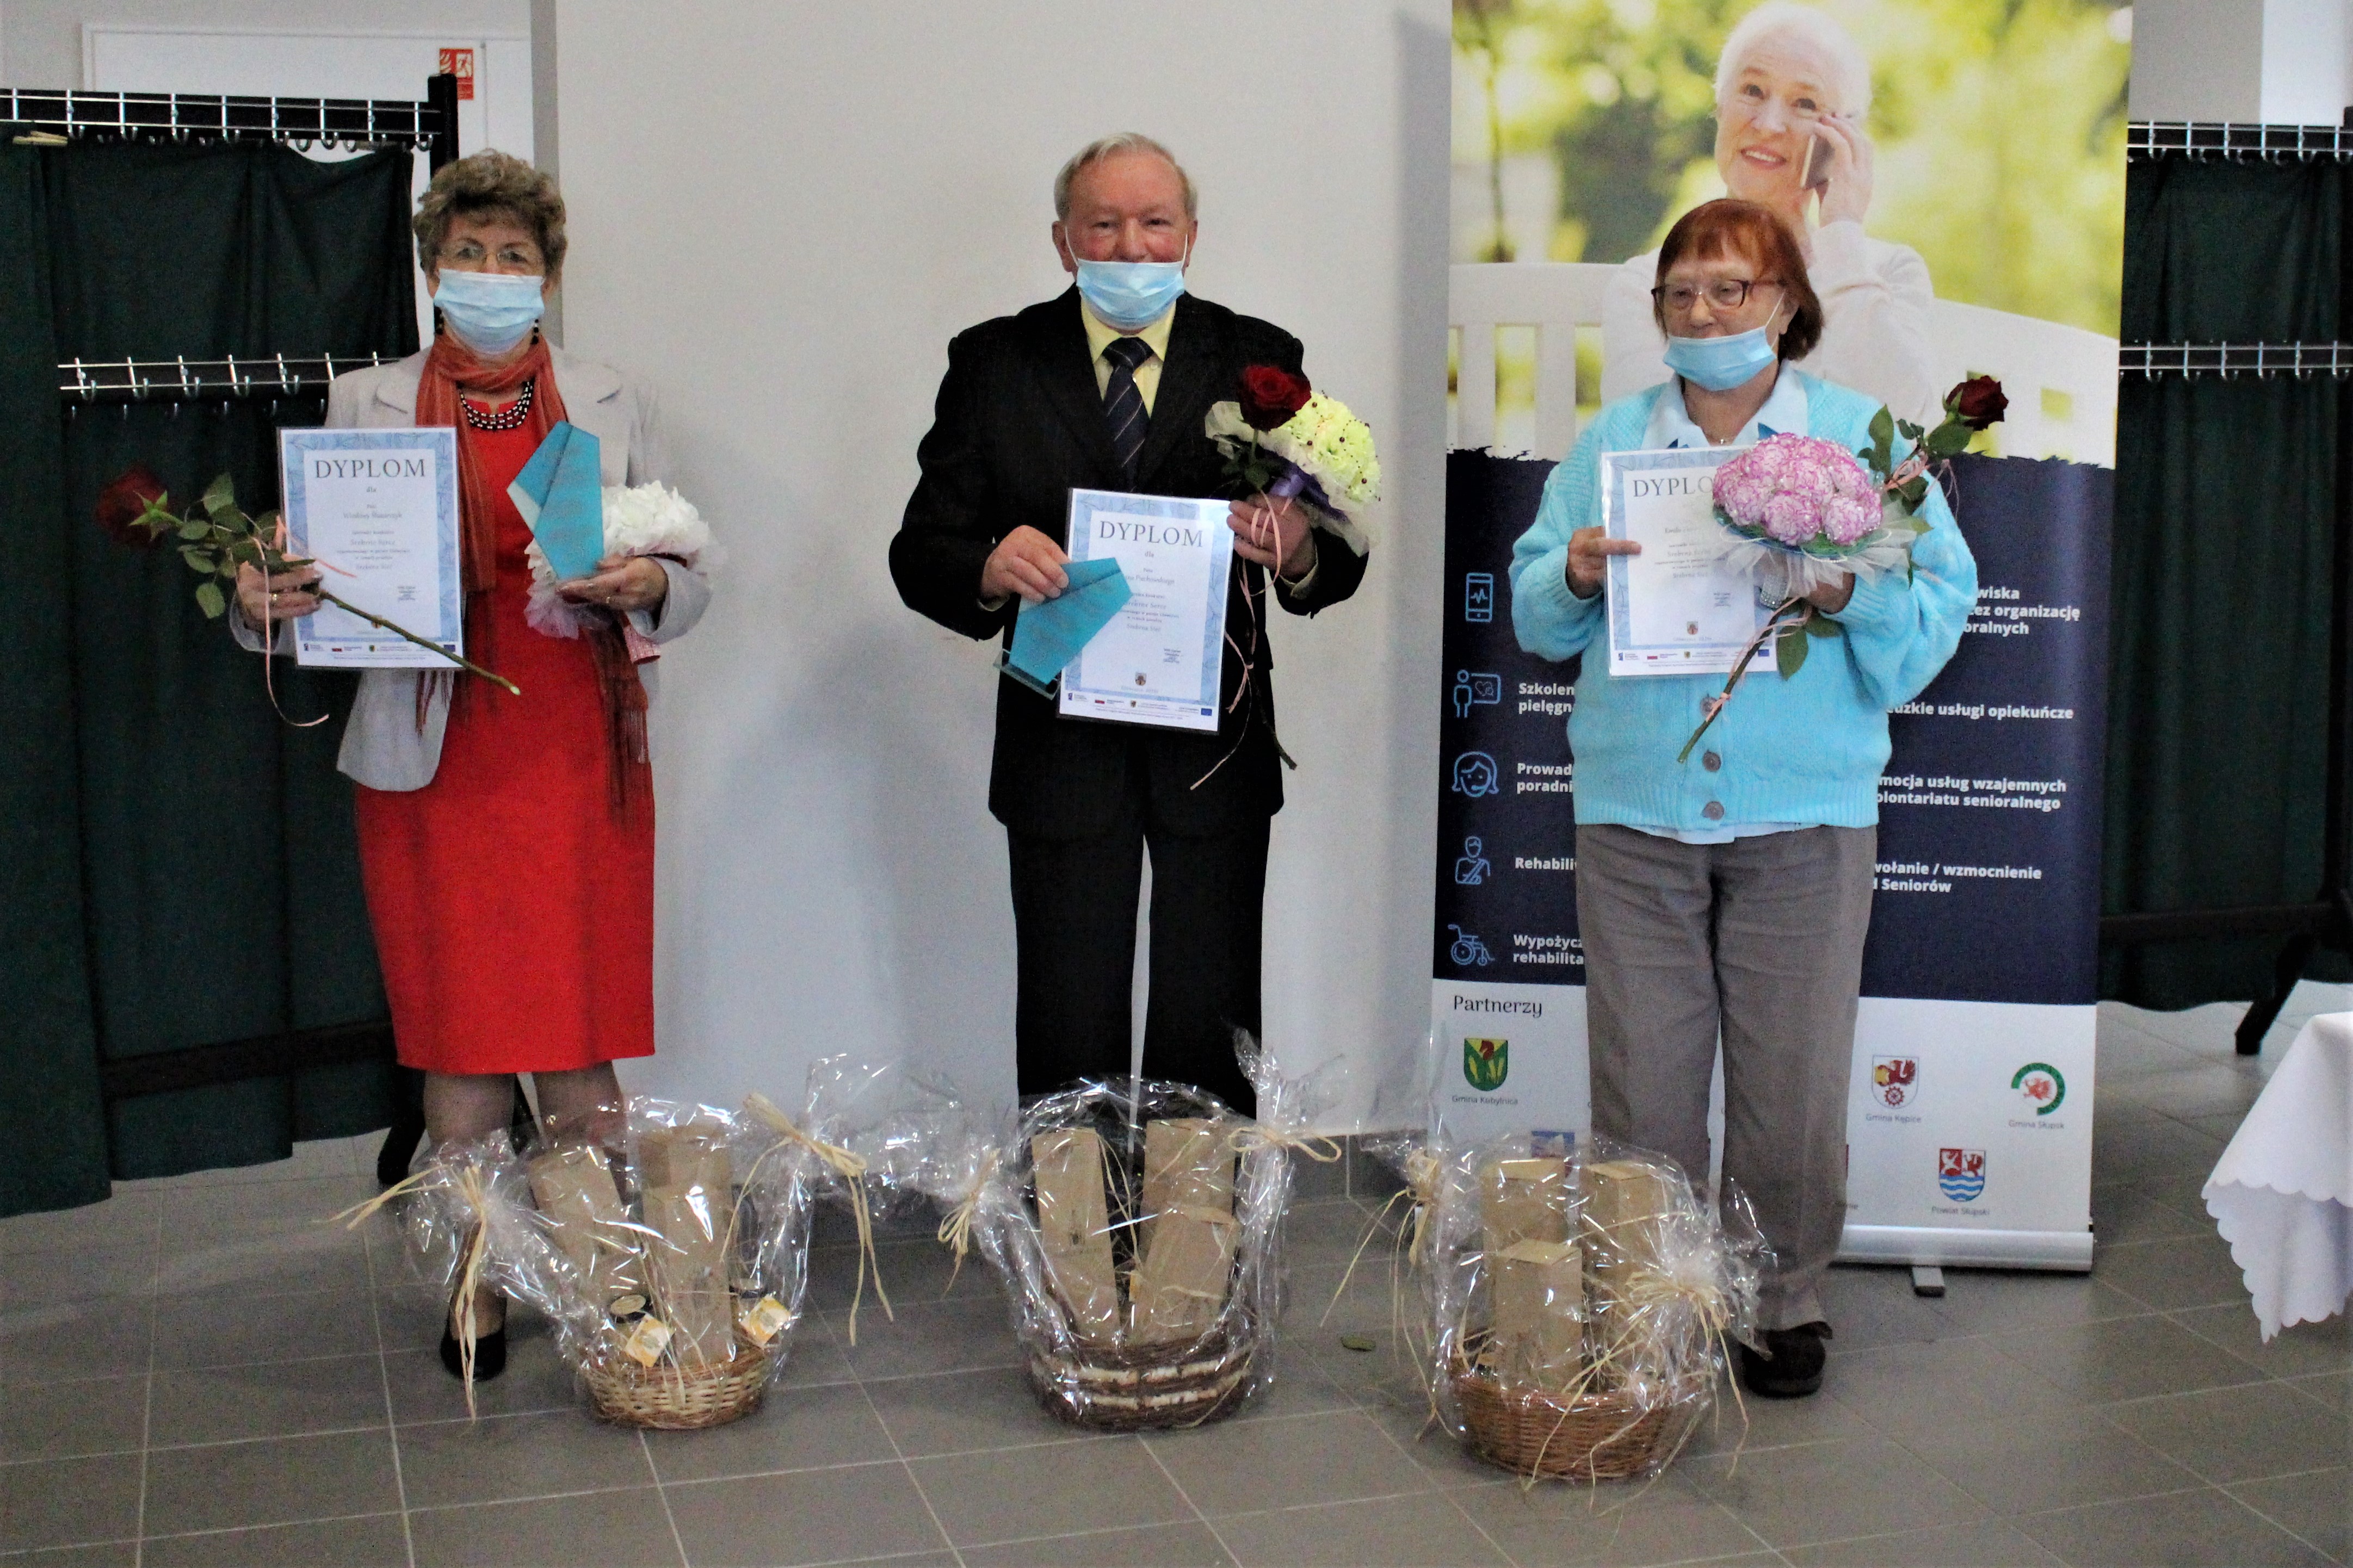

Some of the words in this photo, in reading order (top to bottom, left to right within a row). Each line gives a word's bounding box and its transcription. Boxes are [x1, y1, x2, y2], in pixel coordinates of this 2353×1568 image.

[315, 458, 425, 479] DYPLOM
[1099, 520, 1203, 548] DYPLOM
[1993, 604, 2081, 622] organizację
[1518, 683, 1575, 696] Szkolen
[1518, 699, 1572, 716] pielęgn
[1938, 703, 1985, 720] usługi
[1988, 705, 2074, 721] opiekuńcze
[1517, 763, 1572, 776] Prowad
[1517, 780, 1573, 794] poradni
[1928, 776, 1970, 792] usług
[1972, 778, 2067, 795] wzajemnych
[1963, 796, 2061, 813] senioralnego
[1932, 863, 1940, 876] /
[1943, 865, 2042, 879] wzmocnienie
[1881, 878, 1952, 893] Seniorów
[1513, 951, 1584, 965] rehabilita
[1454, 995, 1542, 1019] Partnerzy
[1452, 1095, 1478, 1104] Gmina
[1866, 1113, 1893, 1122] Gmina
[2008, 1119, 2036, 1129] Gmina
